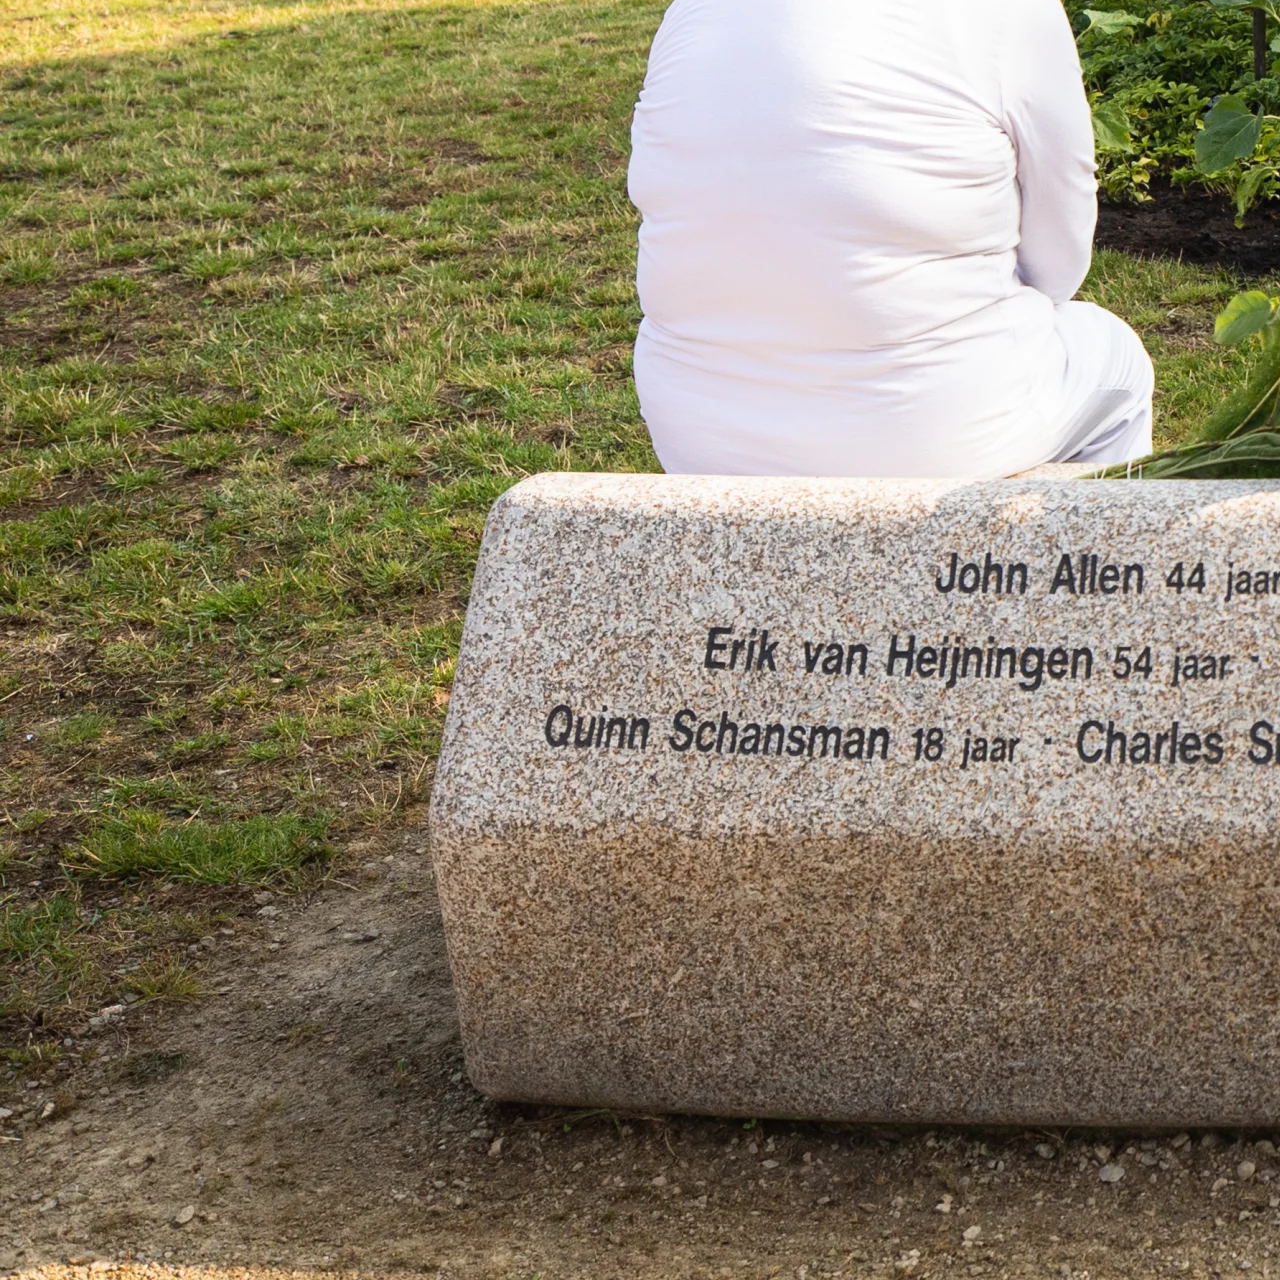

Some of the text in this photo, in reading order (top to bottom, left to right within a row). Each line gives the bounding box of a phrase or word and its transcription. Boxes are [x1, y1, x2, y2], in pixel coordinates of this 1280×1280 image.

[934, 552, 1029, 595] John
[1050, 553, 1145, 596] Allen
[1165, 562, 1208, 592] 44
[703, 626, 778, 673] Erik
[804, 639, 868, 678] van
[886, 632, 1094, 692] Heijningen
[1111, 644, 1155, 680] 54
[1171, 644, 1233, 688] jaar
[544, 703, 651, 752] Quinn
[668, 706, 890, 761] Schansman
[912, 726, 944, 763] 18
[959, 730, 1021, 771] jaar
[1076, 720, 1225, 767] Charles
